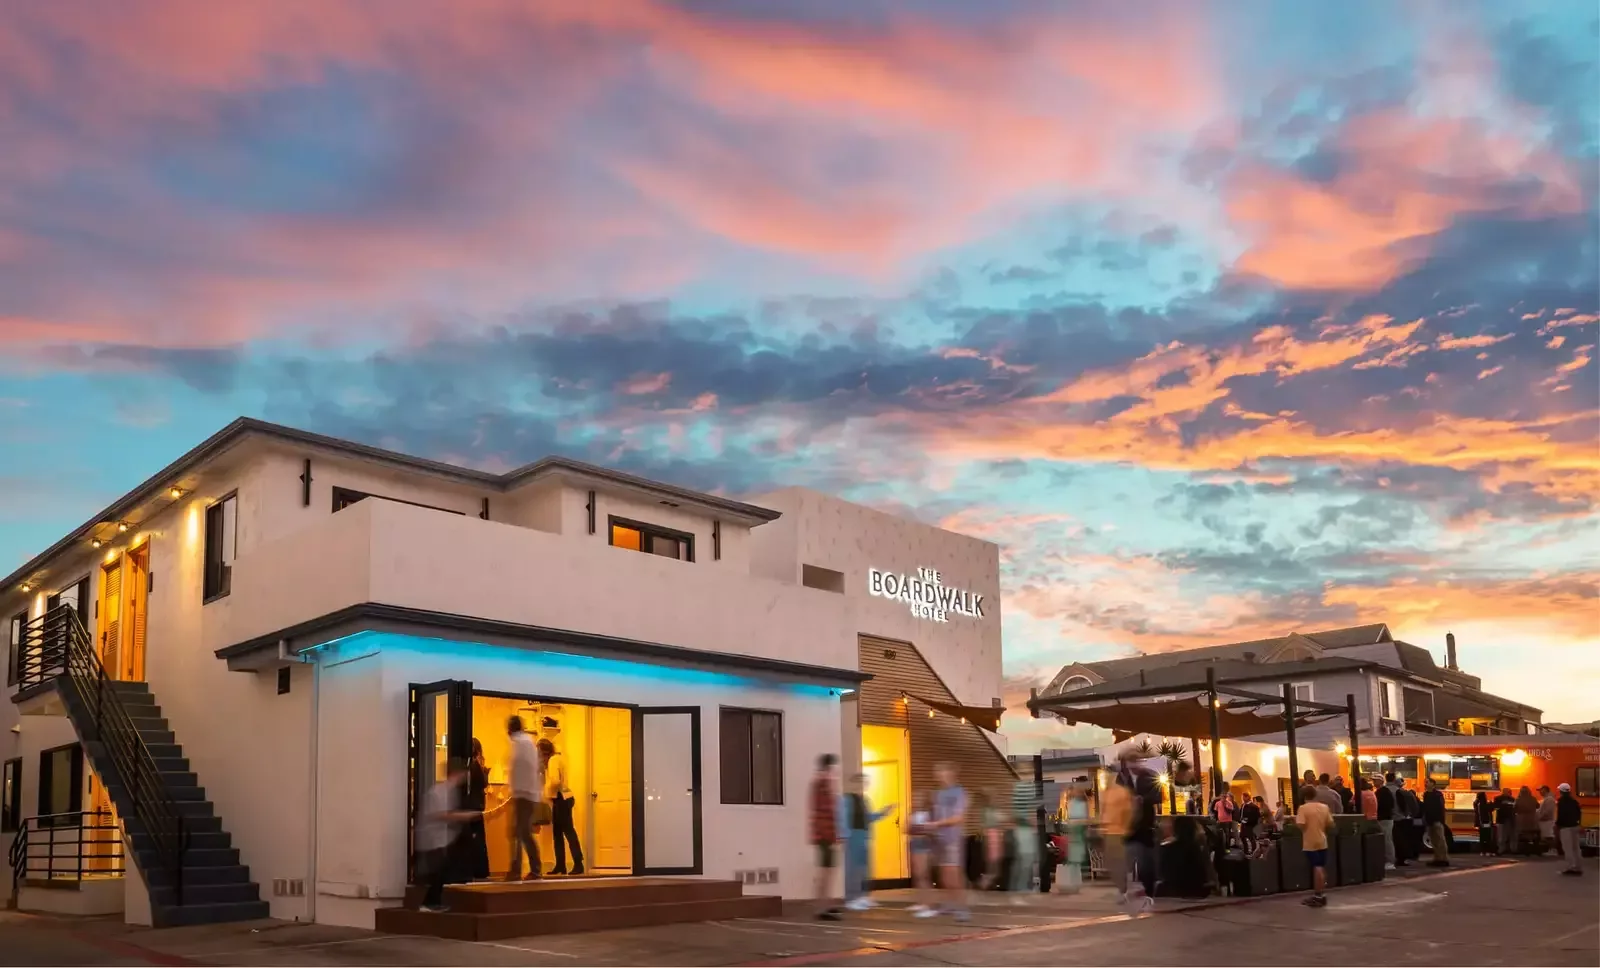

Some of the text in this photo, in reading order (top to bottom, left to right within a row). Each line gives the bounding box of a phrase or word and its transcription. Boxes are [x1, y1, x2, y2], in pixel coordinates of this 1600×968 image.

[918, 567, 941, 583] THE
[870, 569, 985, 618] BOARDWALK
[913, 603, 949, 622] HOTEL
